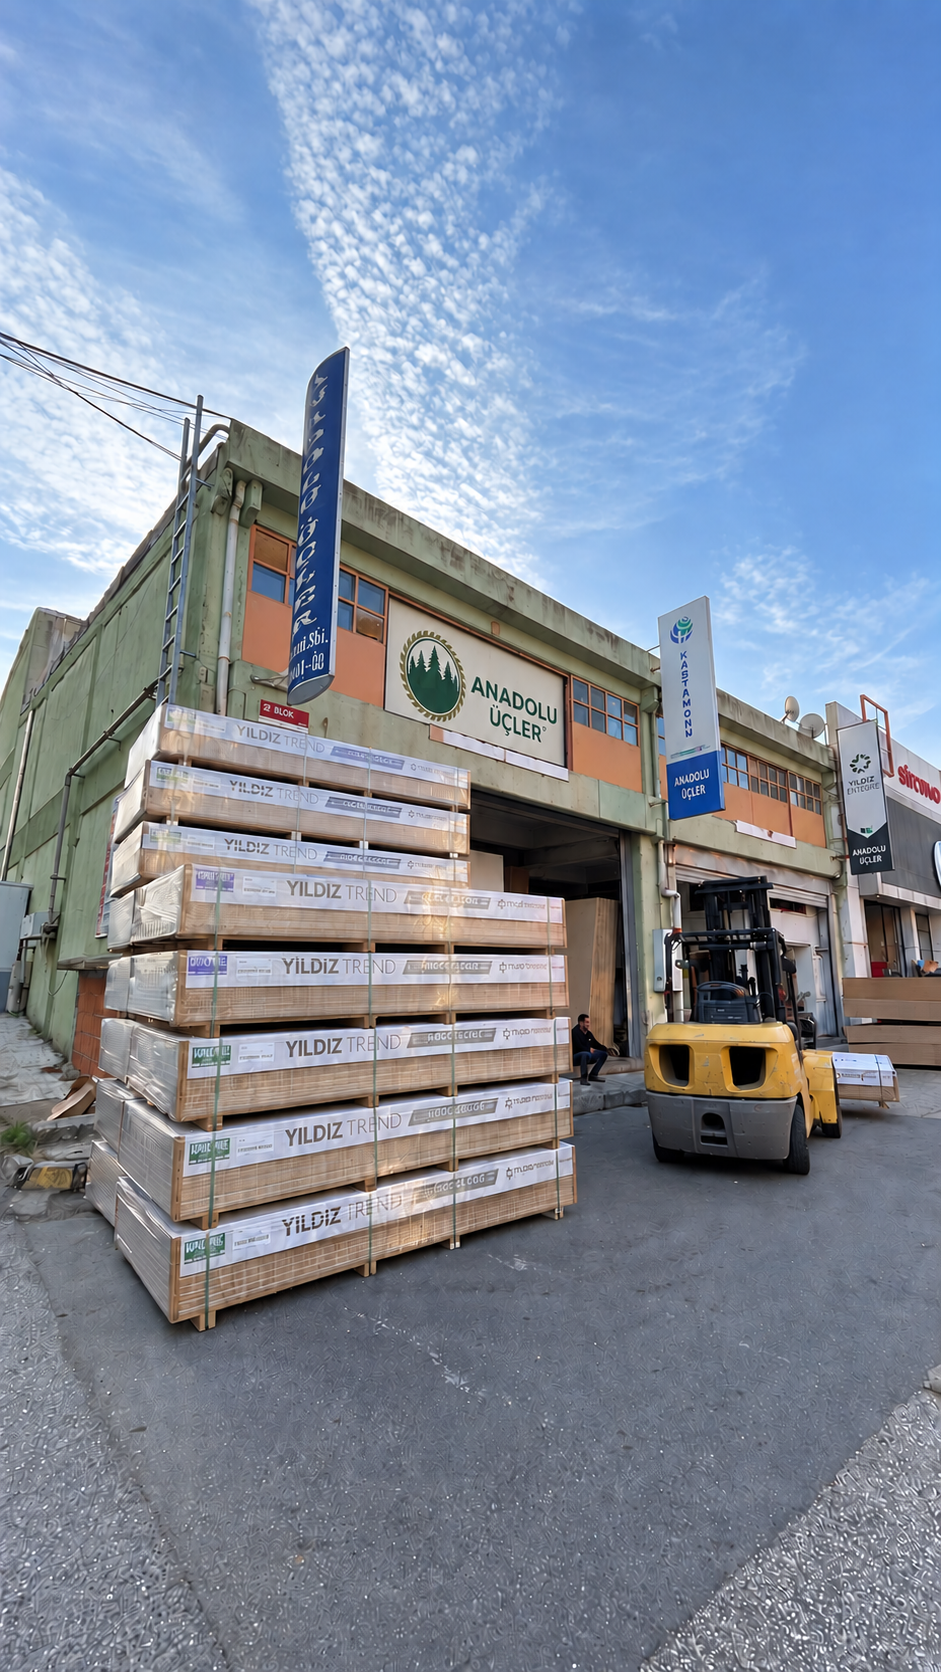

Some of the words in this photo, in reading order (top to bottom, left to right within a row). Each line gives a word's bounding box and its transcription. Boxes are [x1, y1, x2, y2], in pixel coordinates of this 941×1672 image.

[263, 703, 271, 712] 2
[274, 706, 294, 719] BLOK
[470, 676, 558, 725] ANADOLU
[489, 705, 542, 743] ÜÇLER
[236, 724, 281, 745] YILDIZ
[284, 735, 325, 754] TREND
[674, 767, 710, 787] ANADOLU
[848, 775, 875, 787] YILDIZ
[229, 780, 274, 798] YILDIZ
[277, 787, 319, 805] TREND
[224, 838, 270, 855] YILDIZ
[273, 844, 318, 860] TREND
[852, 844, 886, 857] ANADOLU
[286, 880, 342, 900] YILDIZ
[345, 884, 397, 903] TREND
[342, 959, 397, 975] TREND
[285, 1037, 343, 1058] YILDIZ
[346, 1034, 401, 1053] TREND
[284, 1121, 343, 1147] YILDIZ
[347, 1112, 402, 1136] TREND
